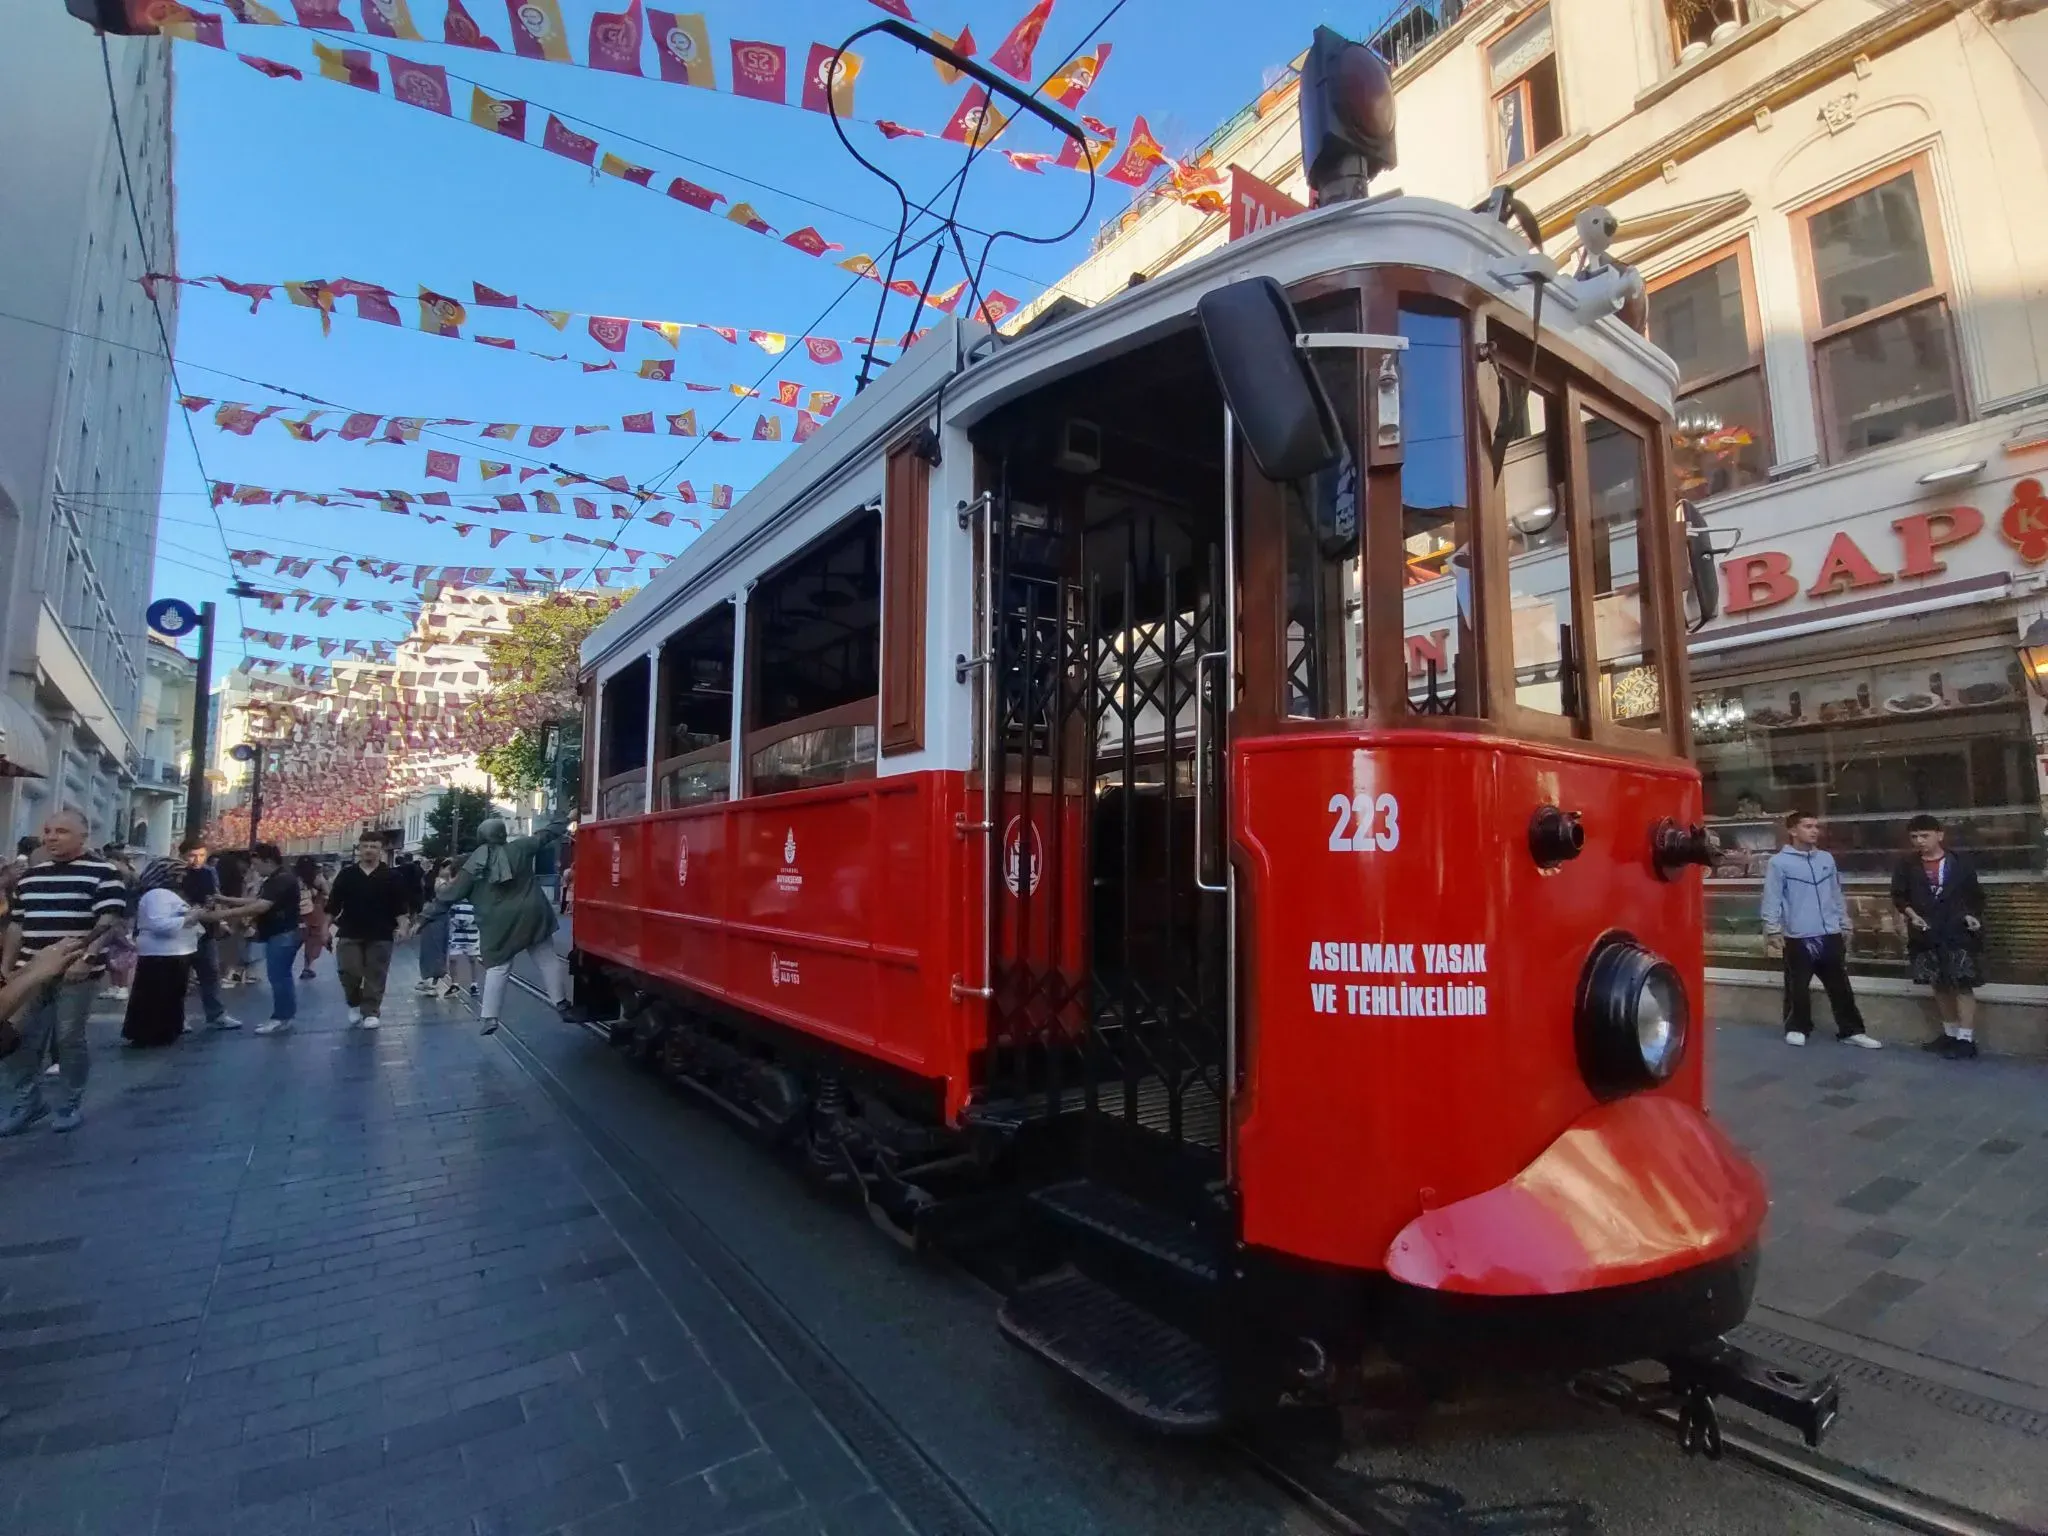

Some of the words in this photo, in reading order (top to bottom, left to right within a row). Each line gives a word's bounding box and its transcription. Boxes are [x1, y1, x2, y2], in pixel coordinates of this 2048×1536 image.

[1328, 793, 1400, 852] 223
[1309, 941, 1415, 974] ASILMAK
[1421, 943, 1487, 974] YASAK
[1311, 983, 1338, 1014] VE
[1345, 980, 1487, 1017] TEHLİKELİDİR
